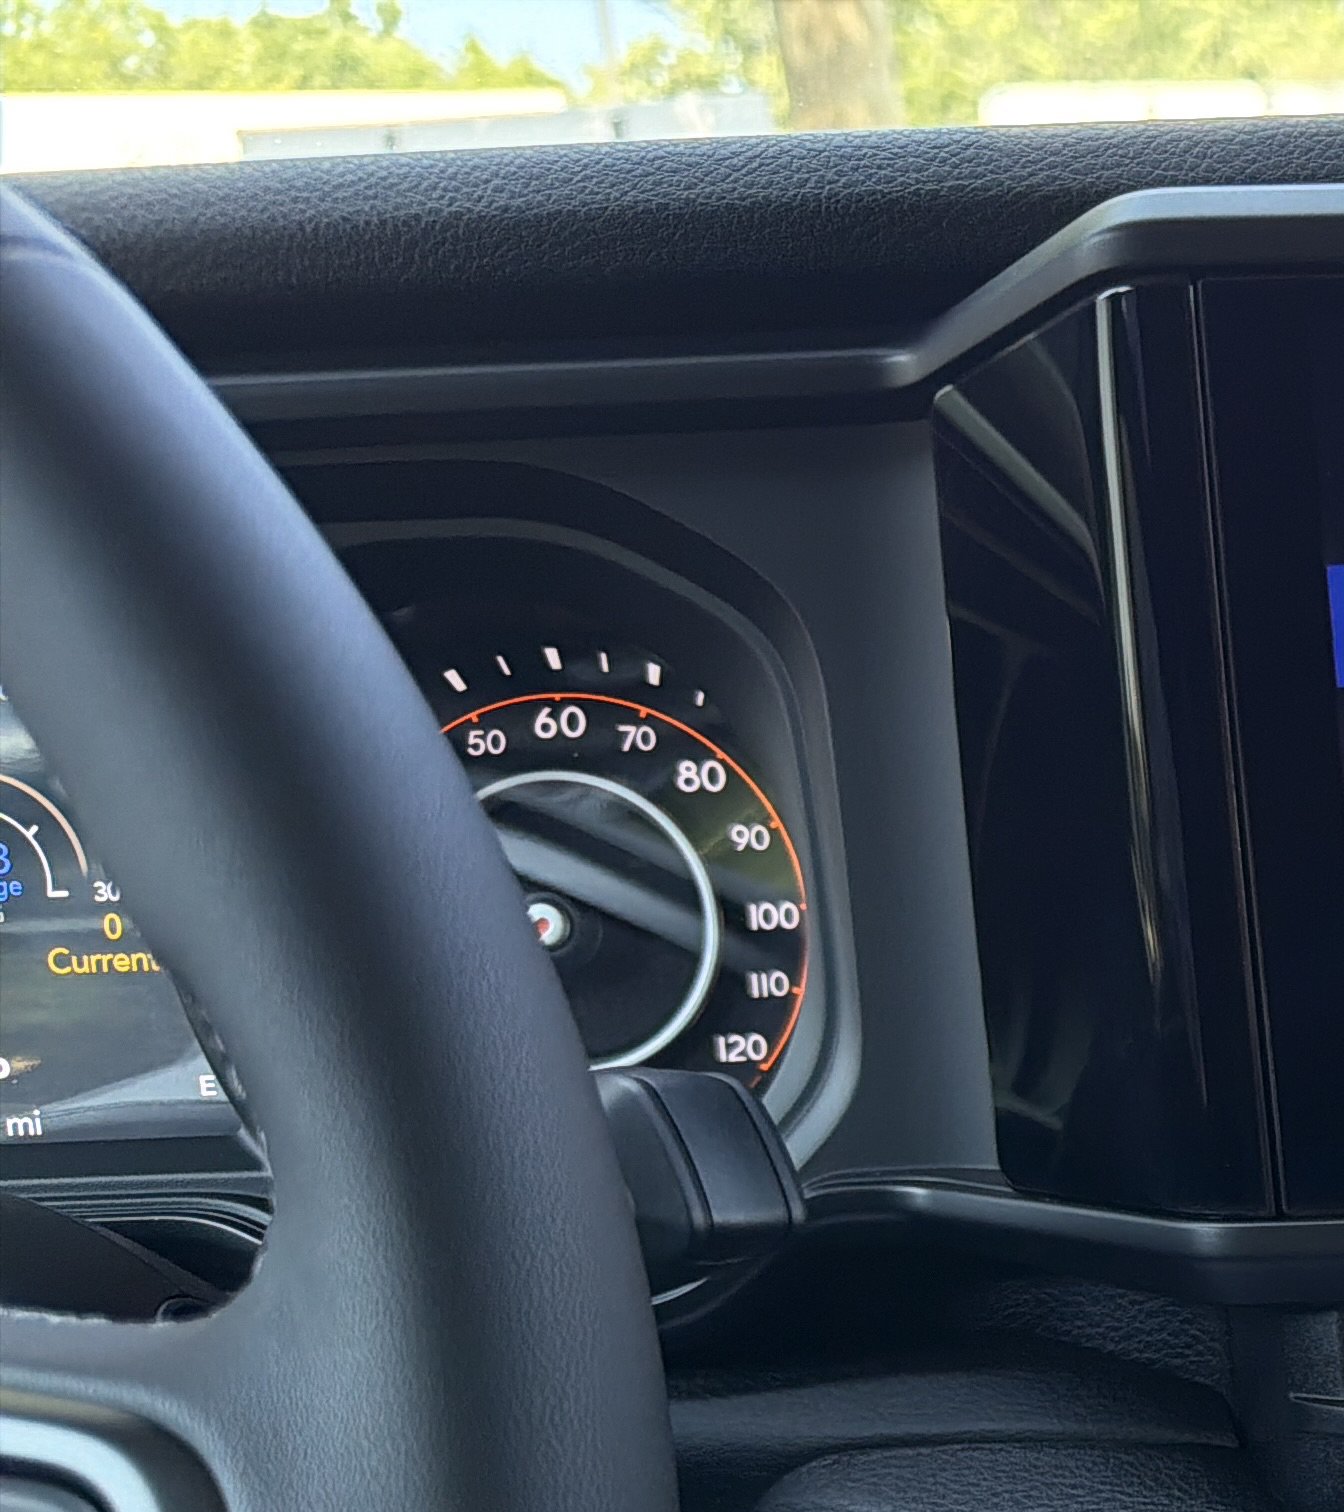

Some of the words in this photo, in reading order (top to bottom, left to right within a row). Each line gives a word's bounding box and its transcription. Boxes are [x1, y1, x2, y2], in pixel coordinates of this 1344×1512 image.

[533, 705, 587, 740] 60
[466, 730, 507, 756] 50
[617, 725, 657, 753] 70
[676, 758, 727, 793] 80
[730, 824, 770, 851] 90
[103, 913, 123, 940] 0
[746, 901, 800, 930] 100
[47, 947, 160, 976] Current
[746, 970, 790, 998] 110
[713, 1033, 767, 1063] 120
[199, 1073, 218, 1096] E
[6, 1109, 43, 1137] mi
